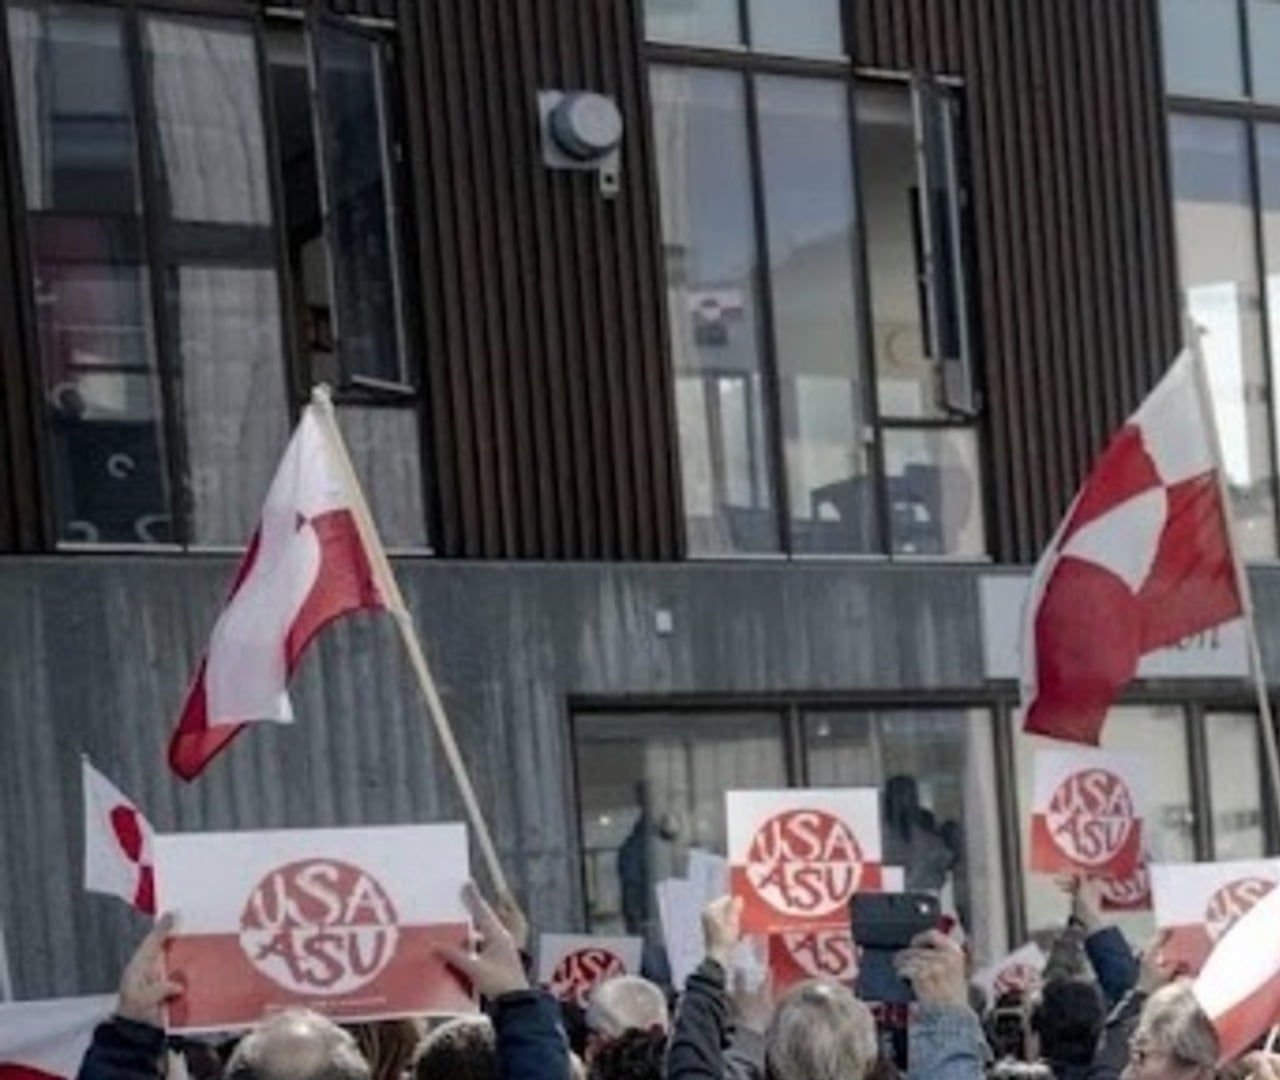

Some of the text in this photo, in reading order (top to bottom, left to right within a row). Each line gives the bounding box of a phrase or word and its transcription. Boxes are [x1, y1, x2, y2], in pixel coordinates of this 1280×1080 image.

[1056, 774, 1130, 816] USA
[757, 813, 858, 862] USA
[1057, 816, 1126, 859] ASU
[253, 864, 391, 928] USA
[759, 862, 854, 910] ASU
[255, 929, 386, 988] ASU
[795, 930, 850, 975] AS
